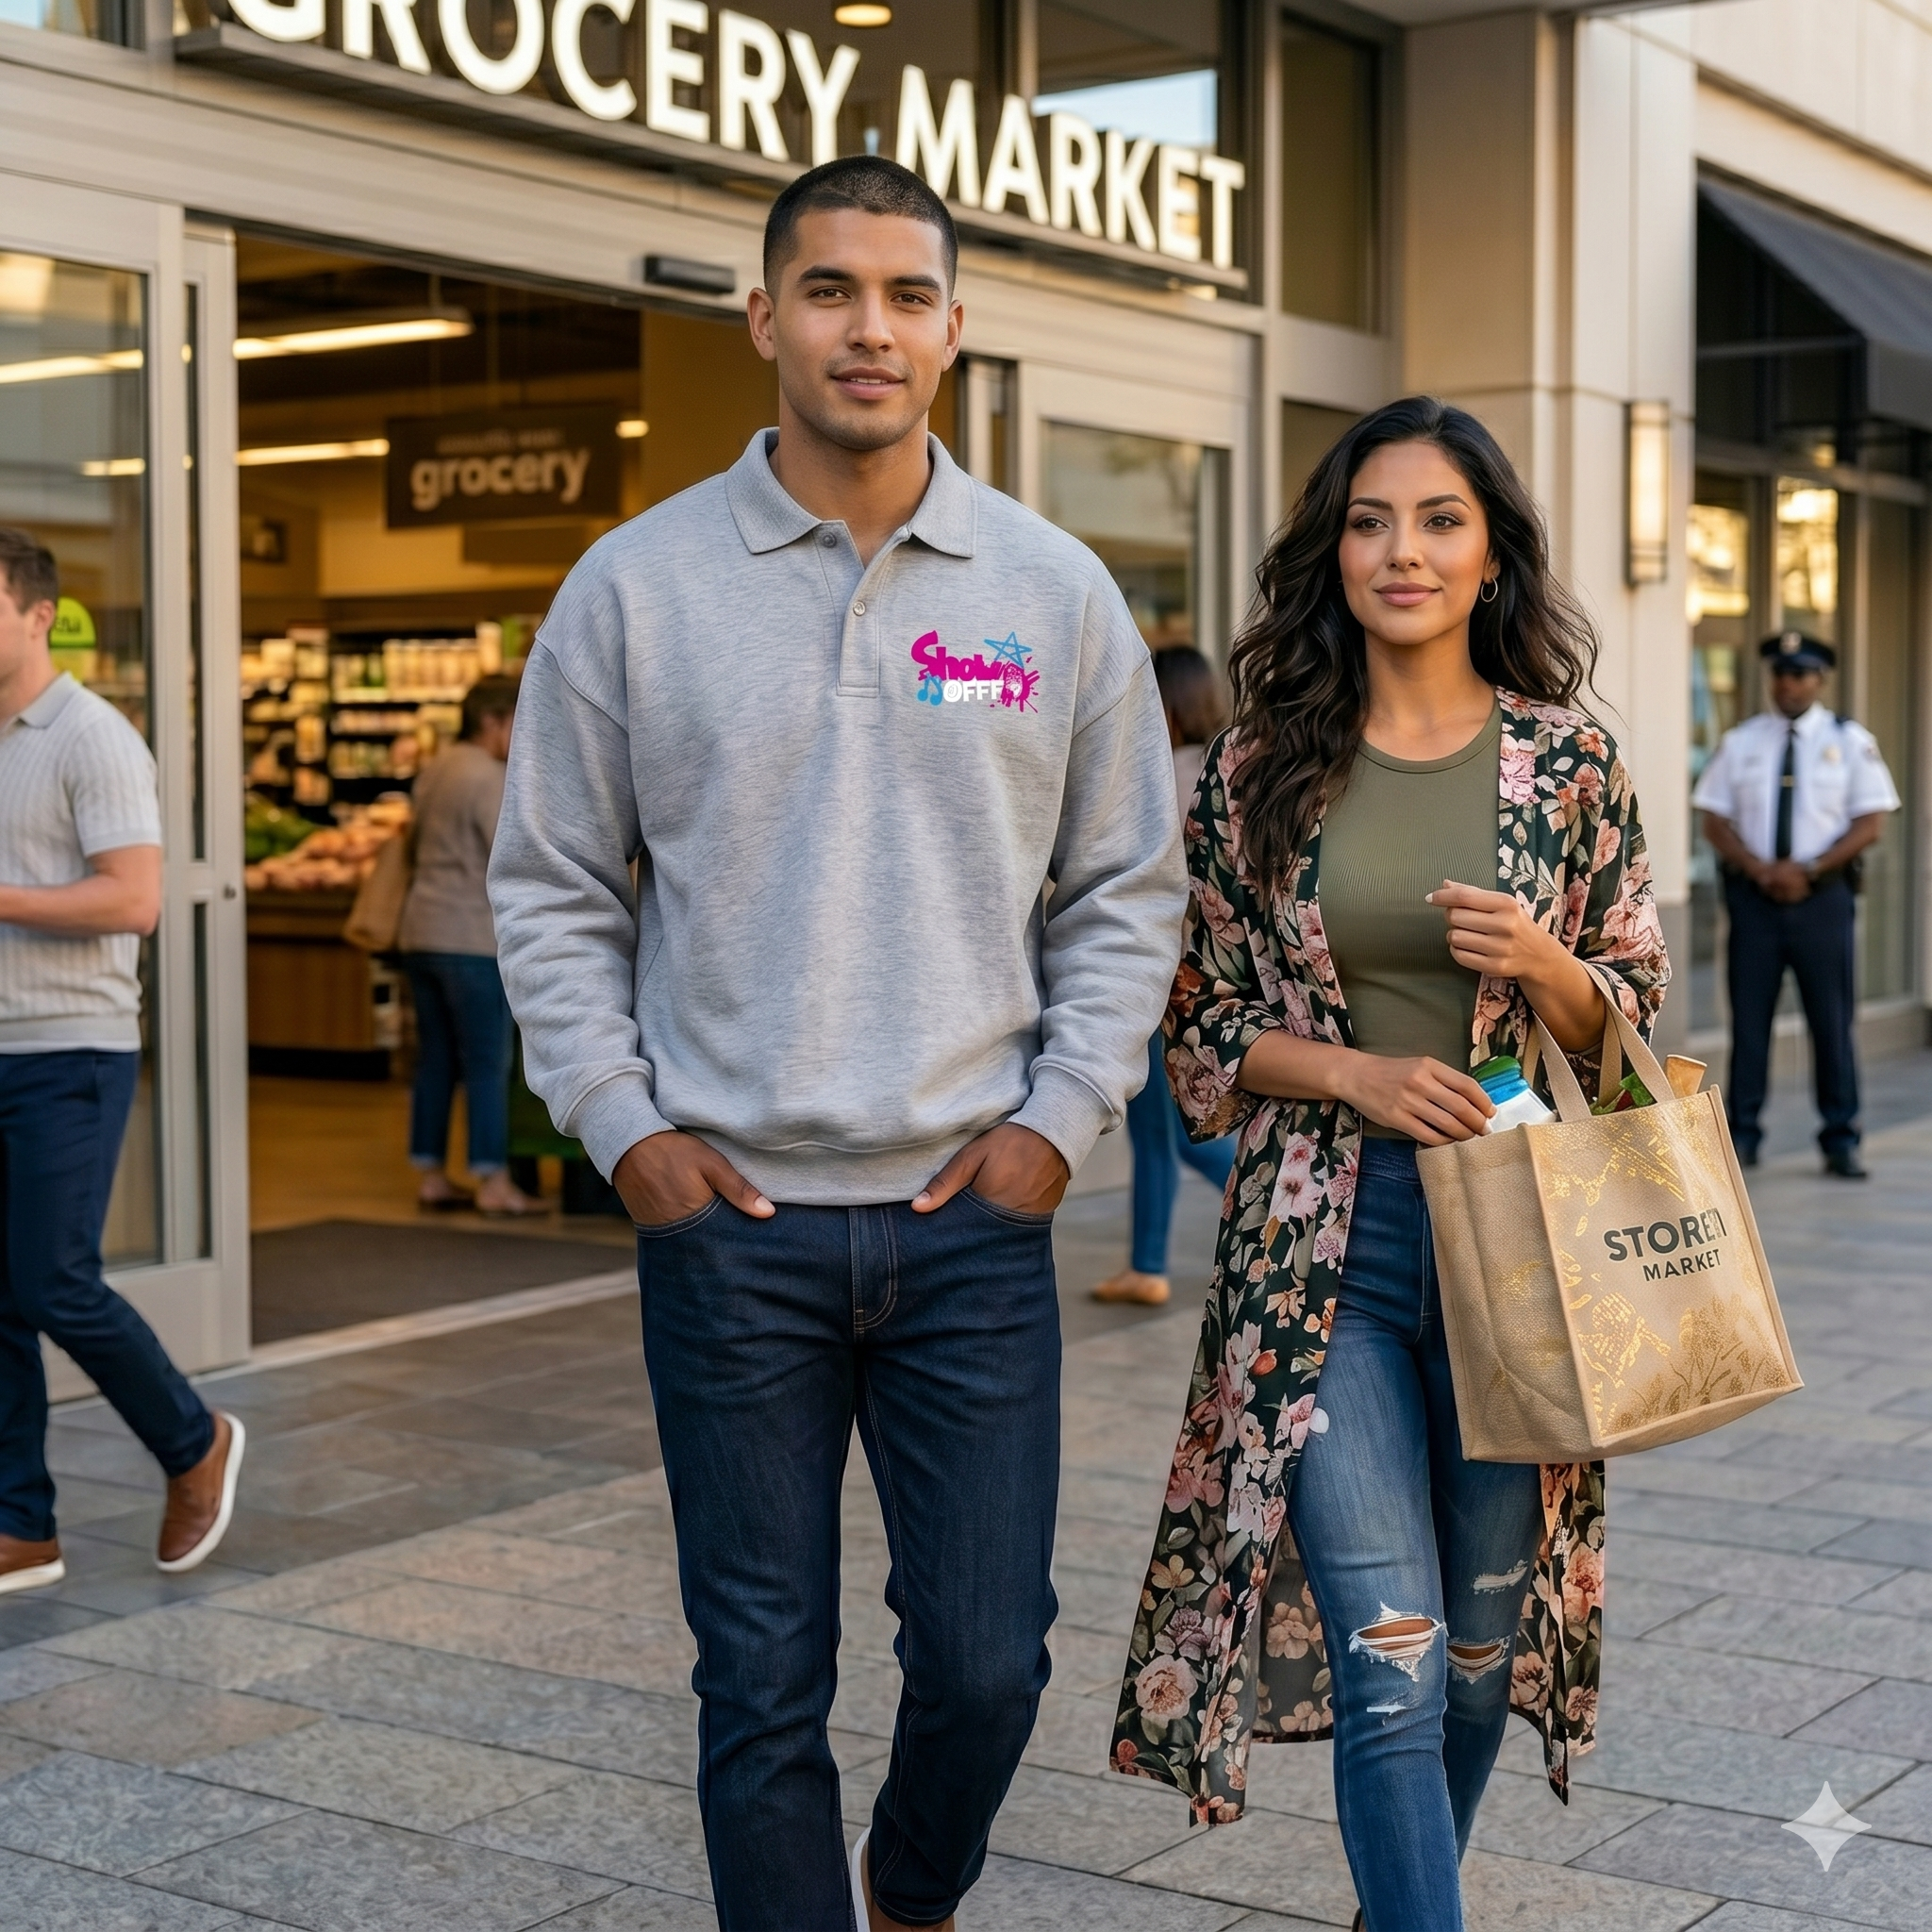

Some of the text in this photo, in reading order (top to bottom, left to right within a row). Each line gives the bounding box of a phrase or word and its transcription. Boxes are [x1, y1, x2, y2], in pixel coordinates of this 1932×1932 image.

[228, 0, 1245, 270] OCERY MARKET
[410, 448, 591, 511] grocery
[1642, 1249, 1721, 1281] MARKET
